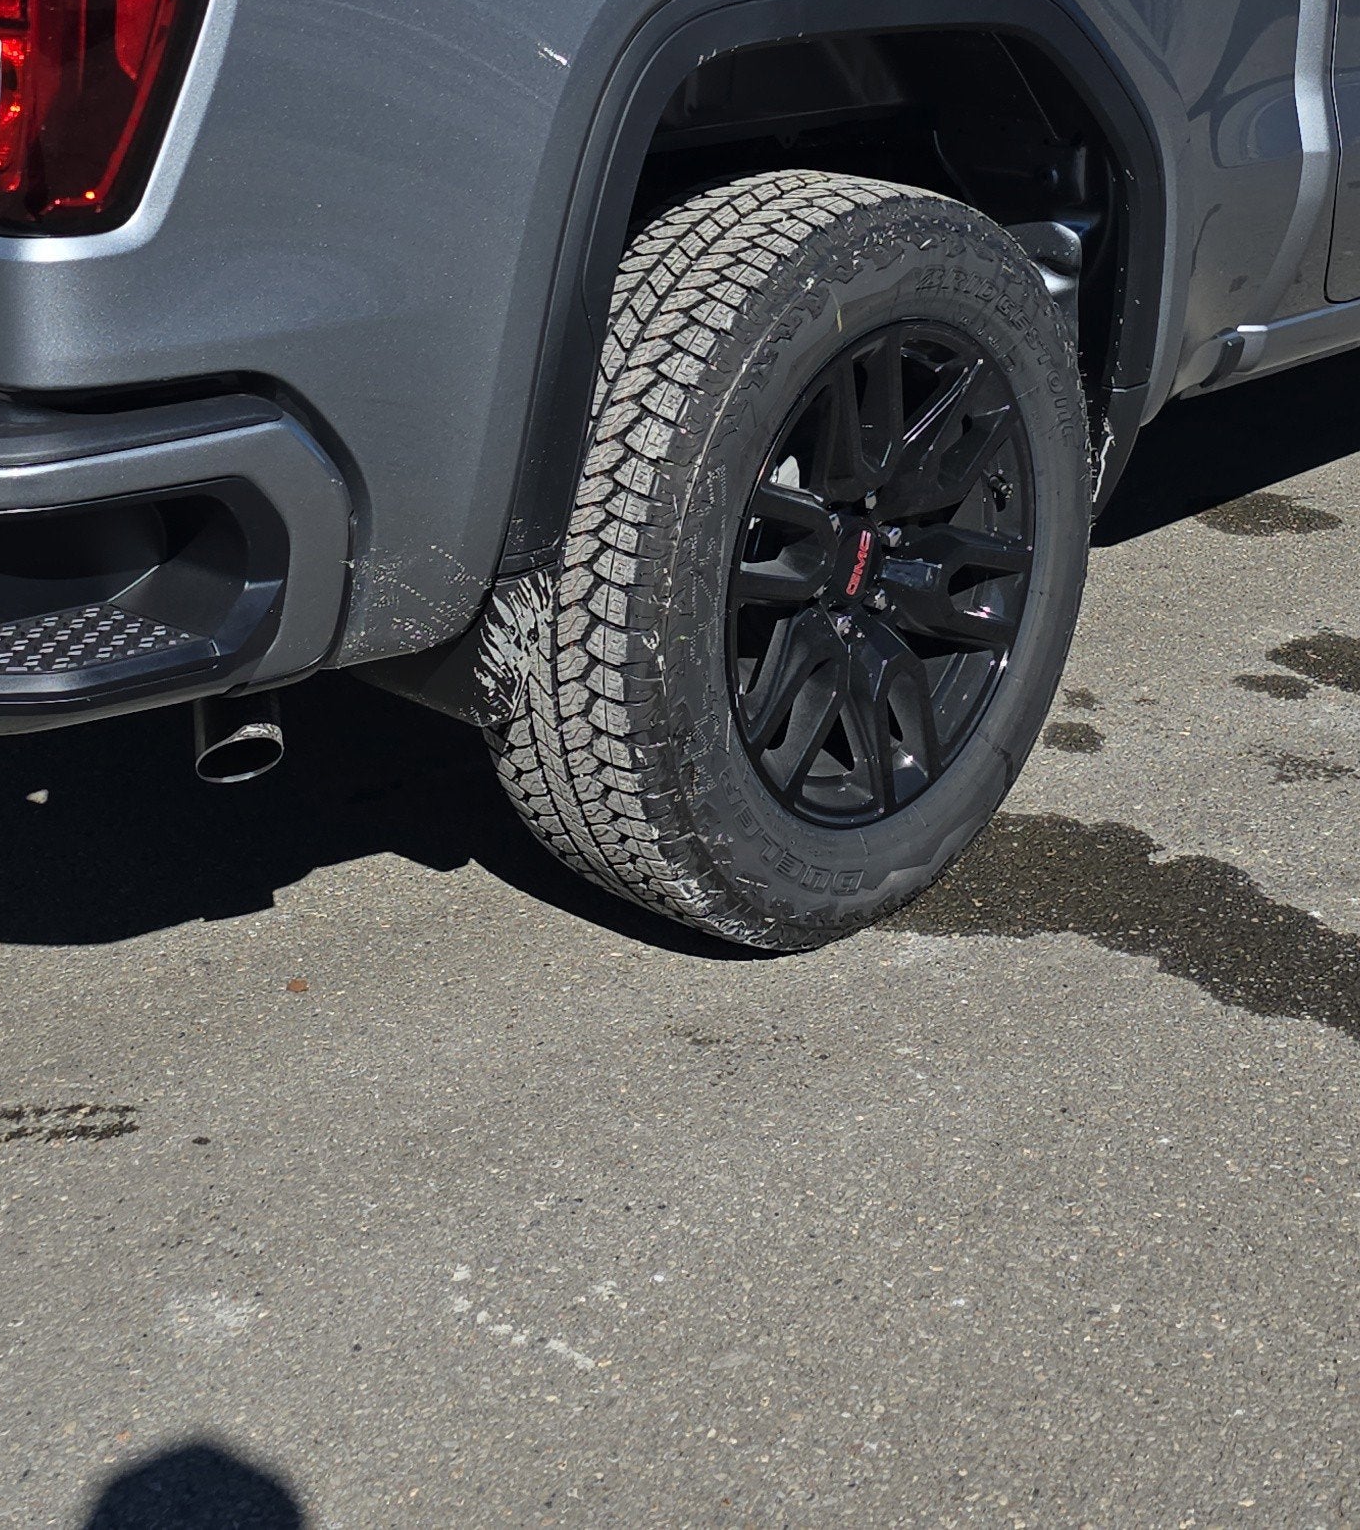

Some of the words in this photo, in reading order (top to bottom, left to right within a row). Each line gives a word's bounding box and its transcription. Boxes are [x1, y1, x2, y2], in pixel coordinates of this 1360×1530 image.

[915, 264, 1077, 449] BRIDGESTONE
[846, 530, 872, 596] GMC
[718, 765, 866, 896] DUELER
